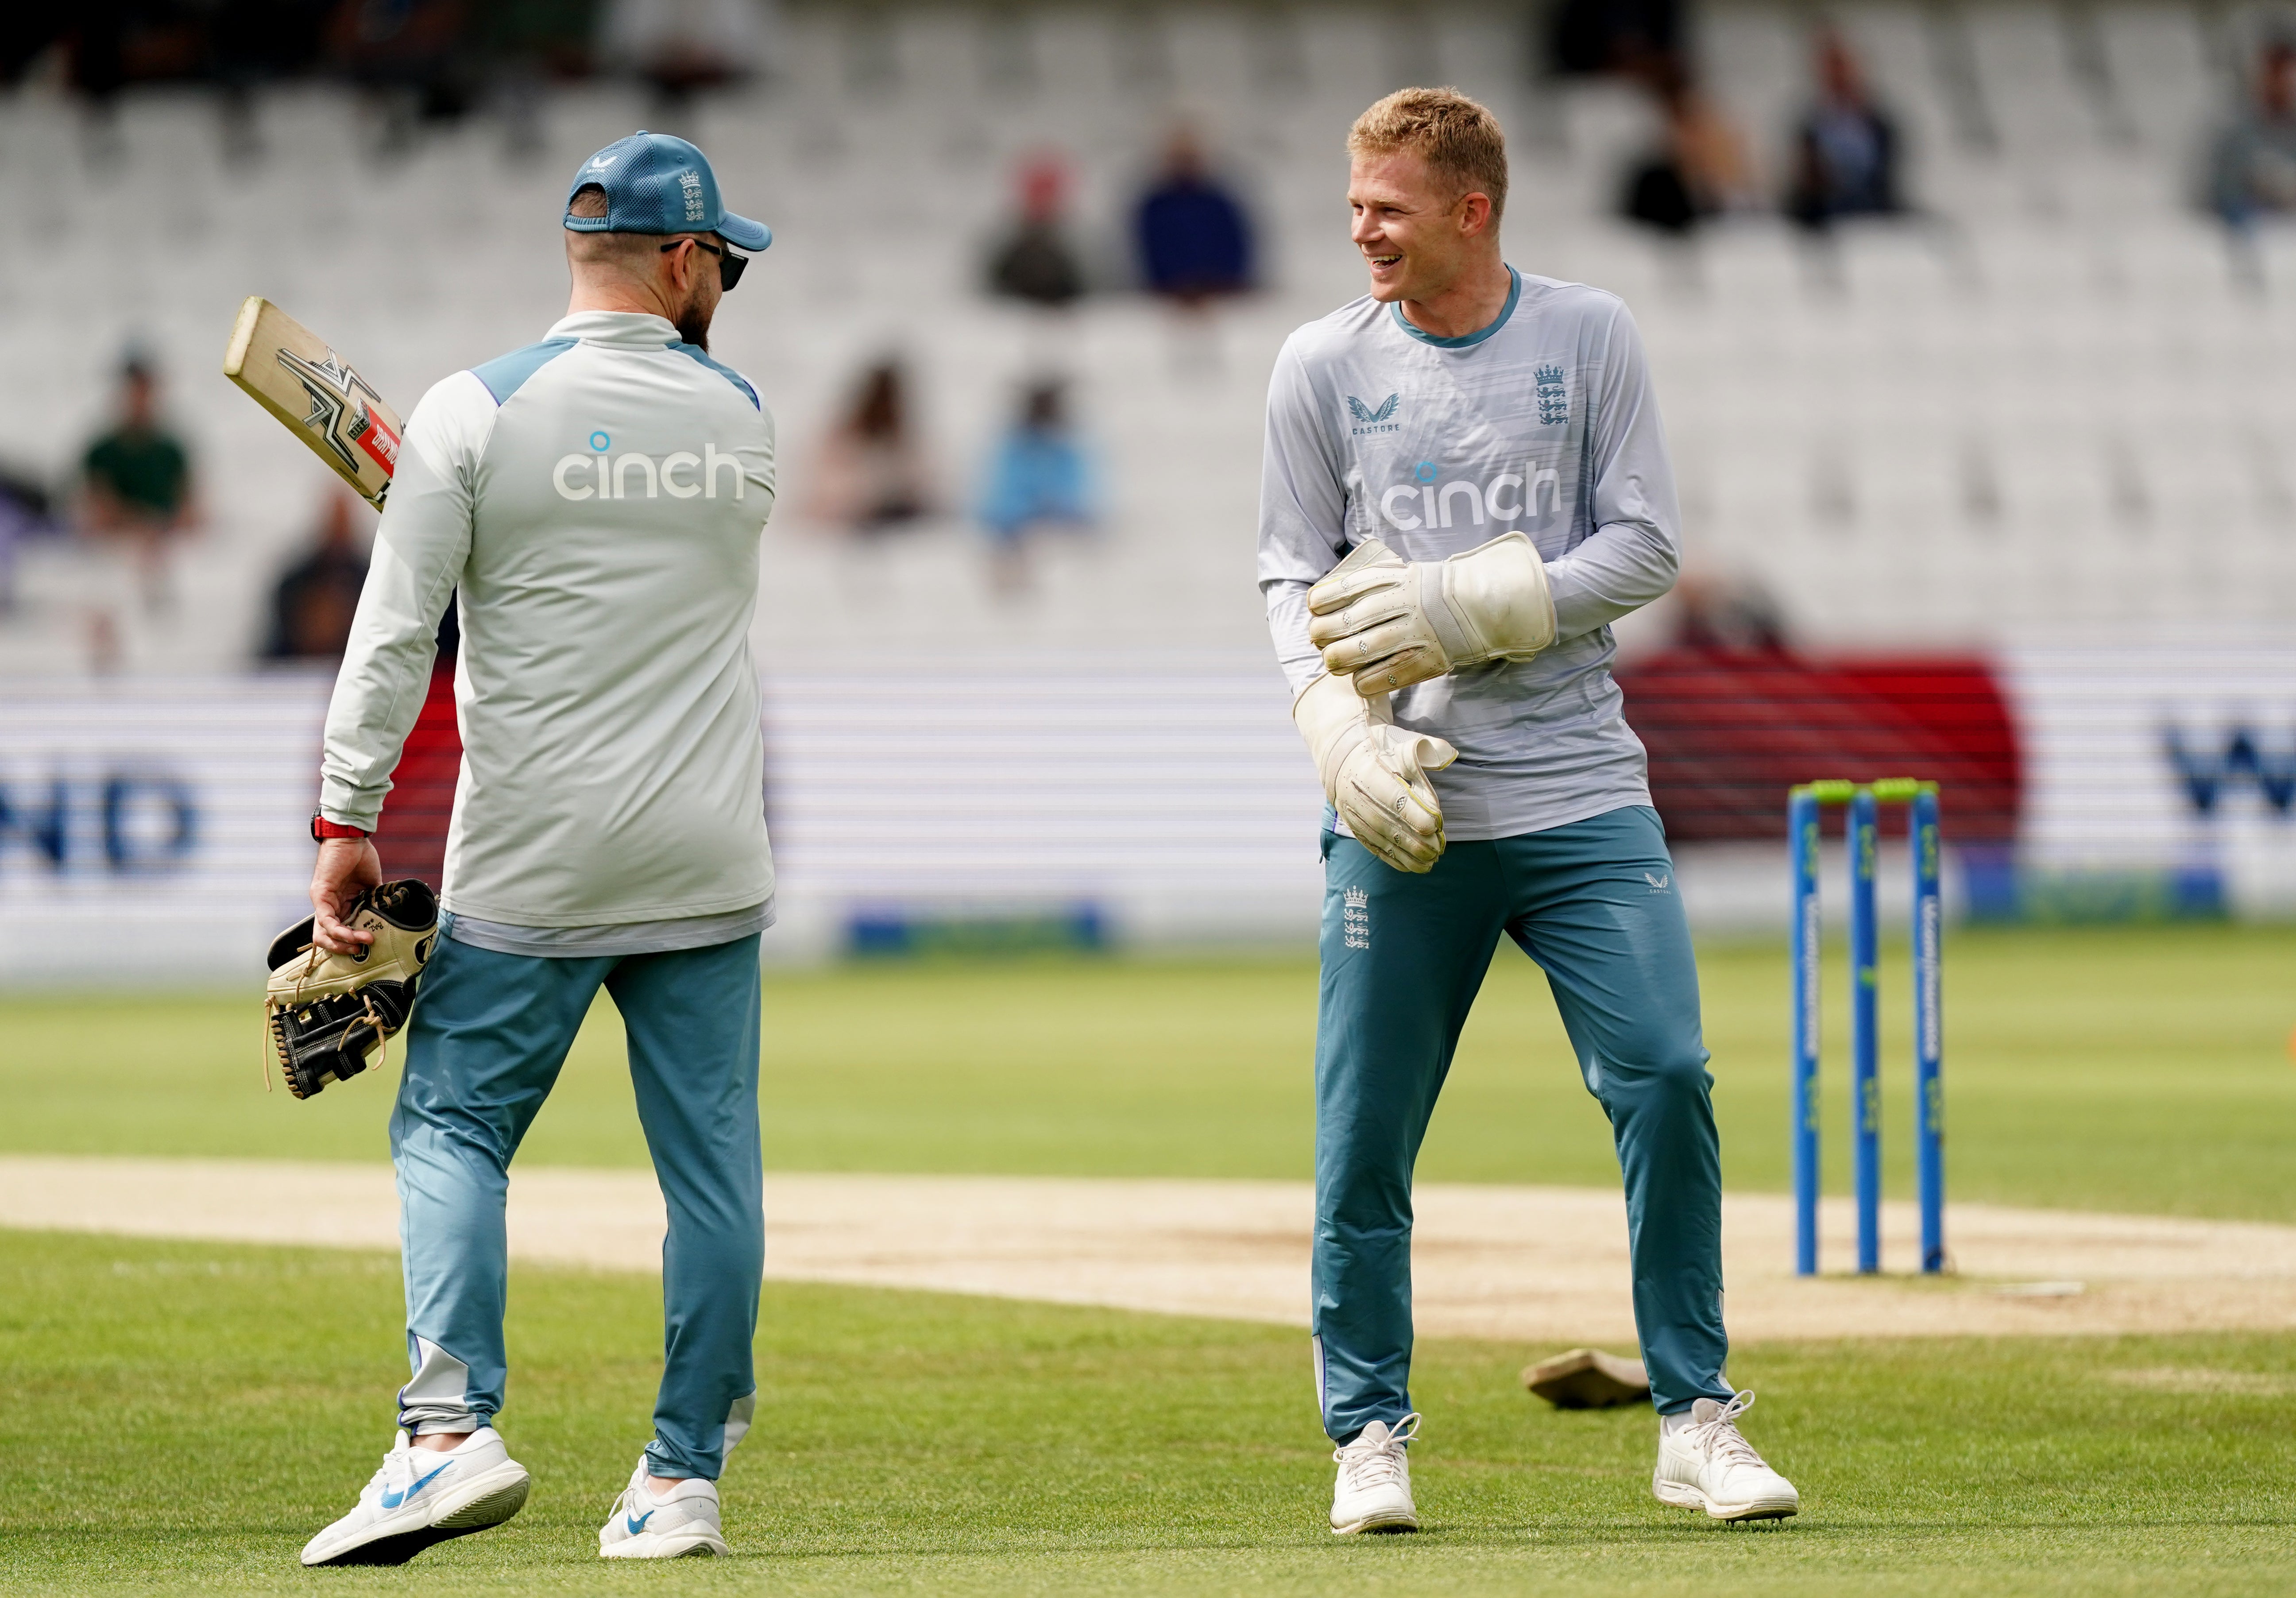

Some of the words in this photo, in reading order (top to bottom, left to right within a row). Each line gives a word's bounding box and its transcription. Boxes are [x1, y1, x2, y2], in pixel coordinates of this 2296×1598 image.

[1353, 424, 1399, 434] CASTORE
[553, 431, 744, 501] cinch
[1381, 460, 1561, 531] cinch
[369, 921, 383, 932] BAZ
